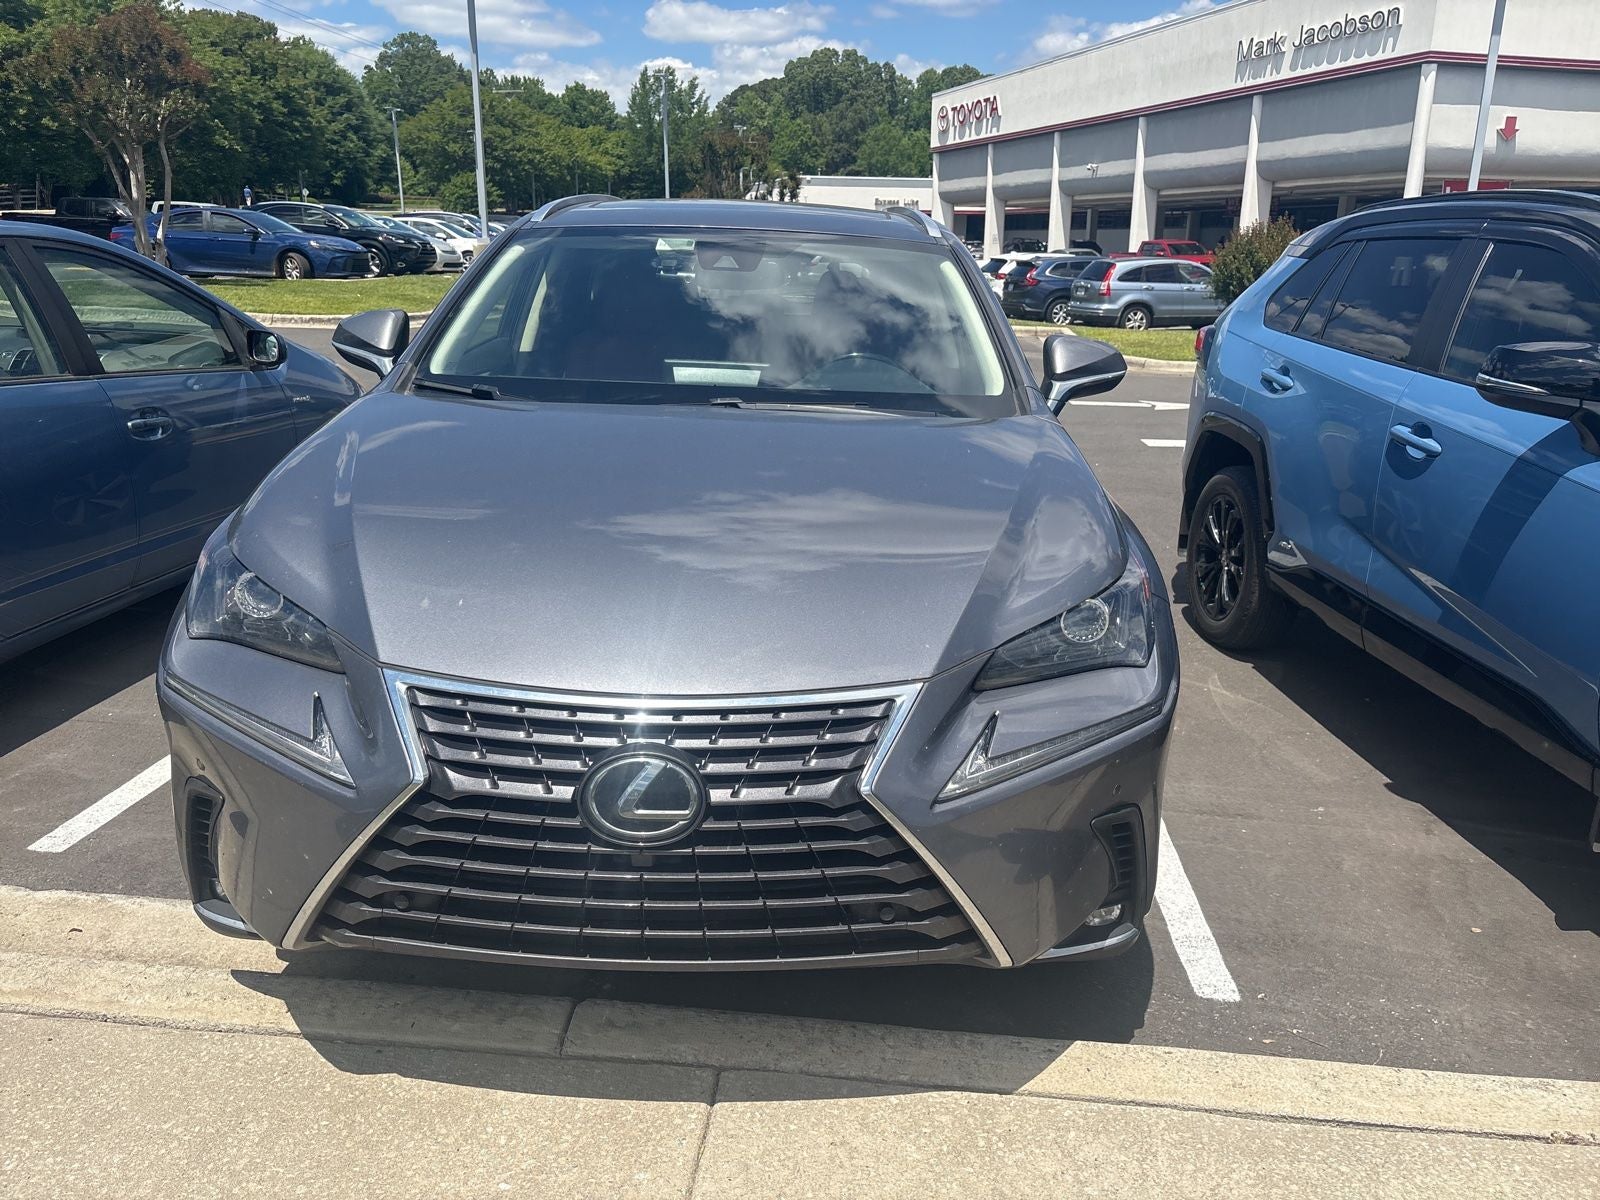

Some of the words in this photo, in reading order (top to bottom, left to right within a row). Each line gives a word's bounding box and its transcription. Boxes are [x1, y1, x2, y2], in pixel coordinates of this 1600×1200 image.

[1236, 31, 1287, 62] Mark
[1292, 6, 1401, 49] Jacobson
[951, 95, 999, 127] TOYOTA
